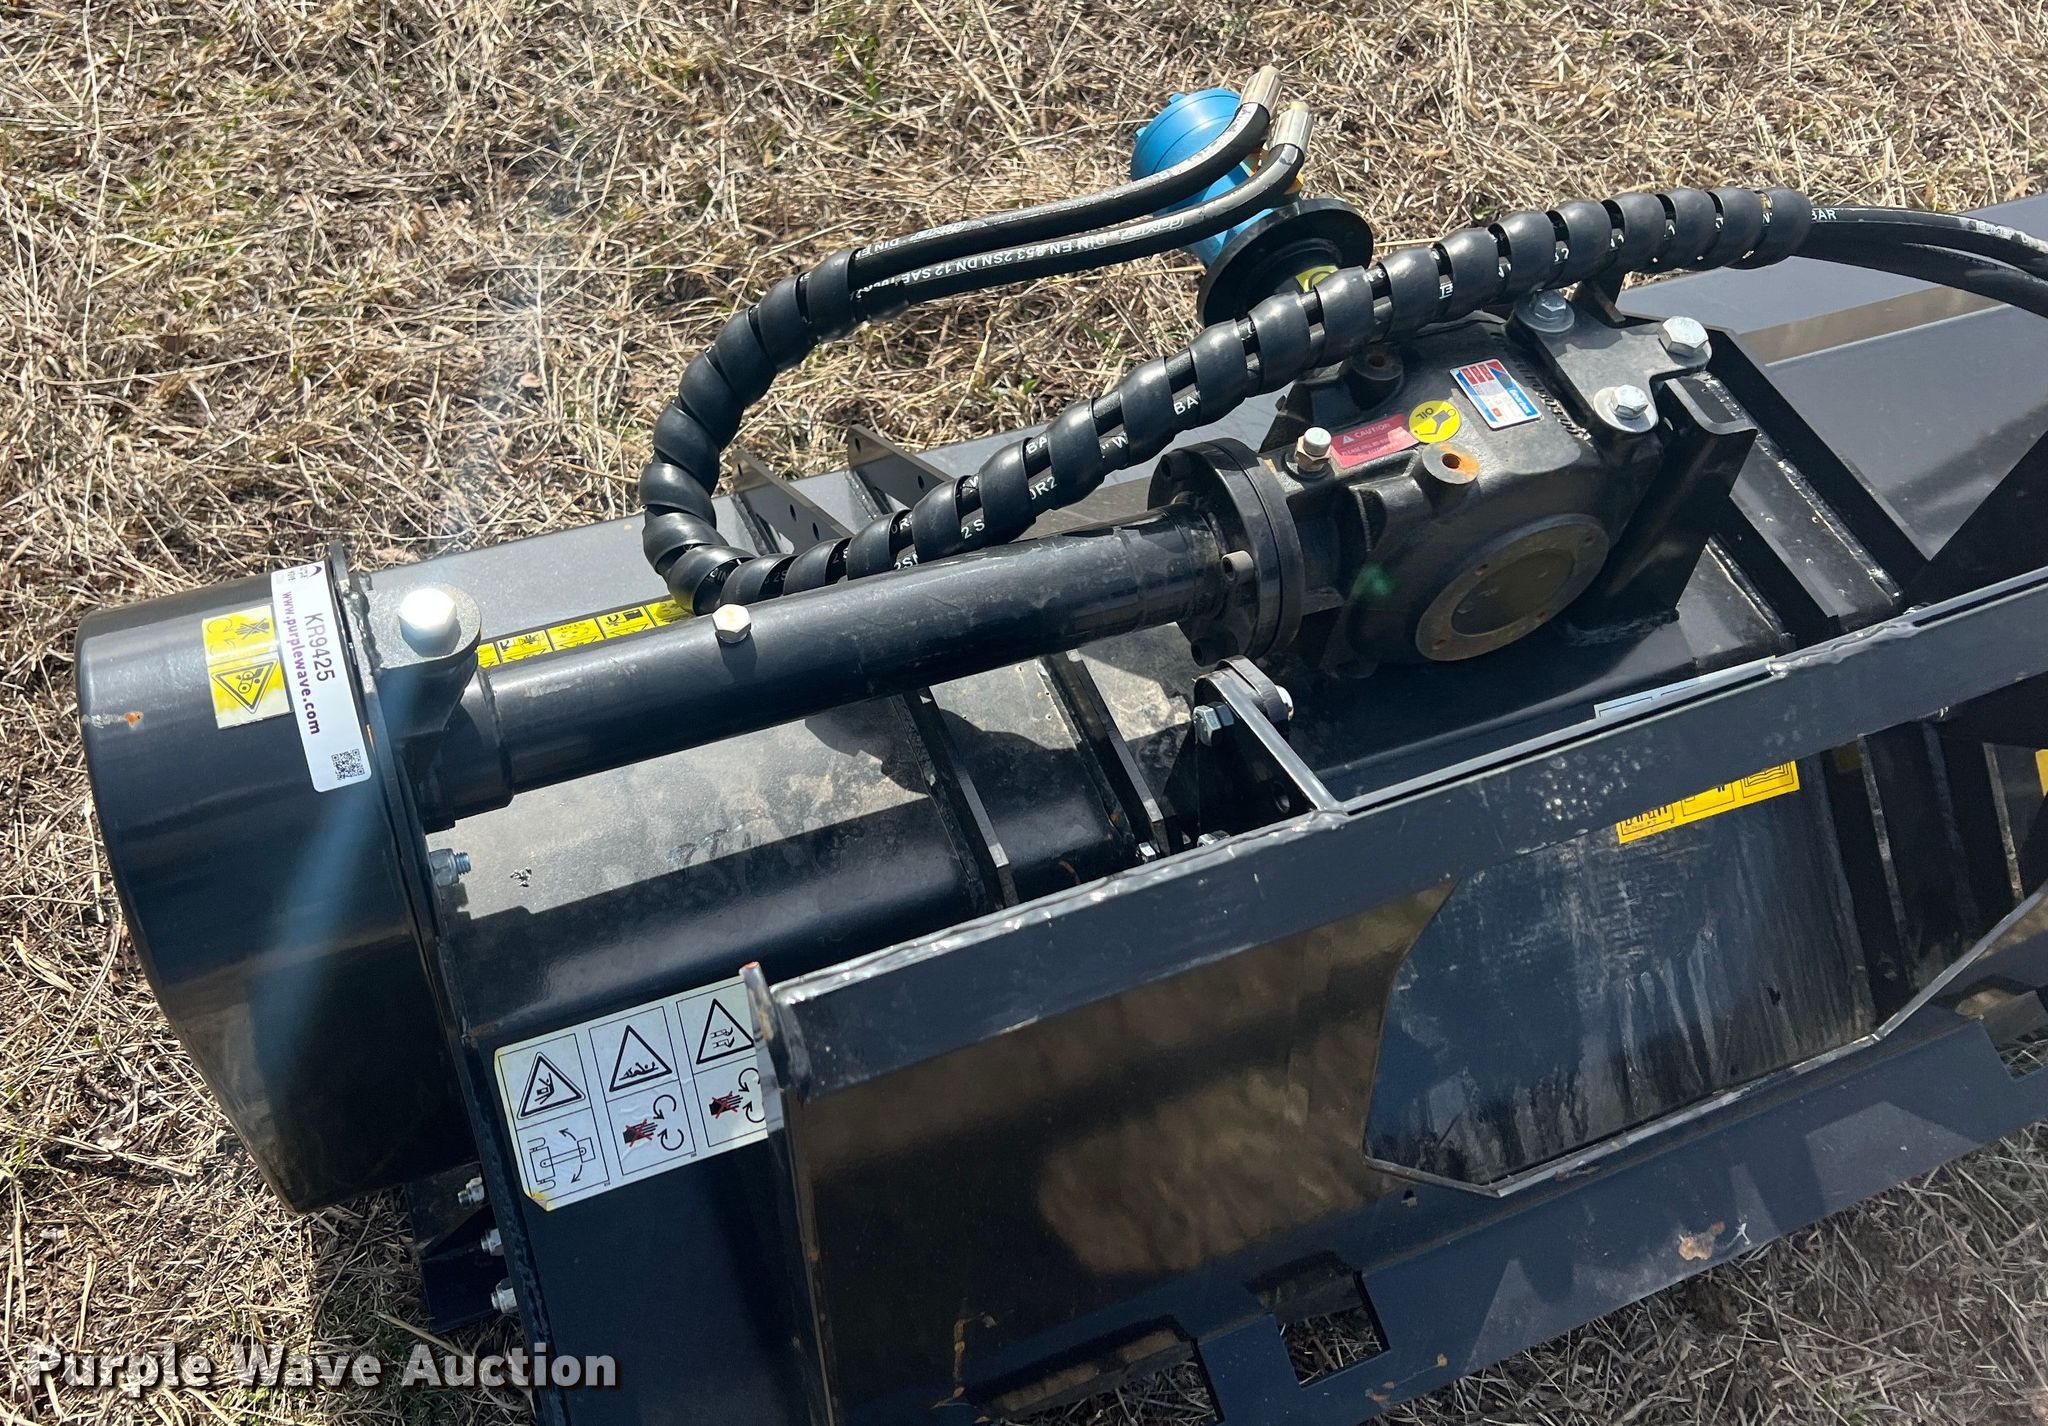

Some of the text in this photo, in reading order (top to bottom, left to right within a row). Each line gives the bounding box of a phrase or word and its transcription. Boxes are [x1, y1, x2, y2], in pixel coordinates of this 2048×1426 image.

[1050, 242, 1072, 256] EN
[957, 256, 978, 273] DN
[982, 250, 1012, 267] 2SN
[903, 266, 931, 284] SAE
[936, 261, 951, 277] 12
[1415, 407, 1434, 420] OIL
[1354, 422, 1391, 438] CAUTION
[304, 612, 336, 682] KR9425
[282, 591, 320, 735] www.purplewave.com
